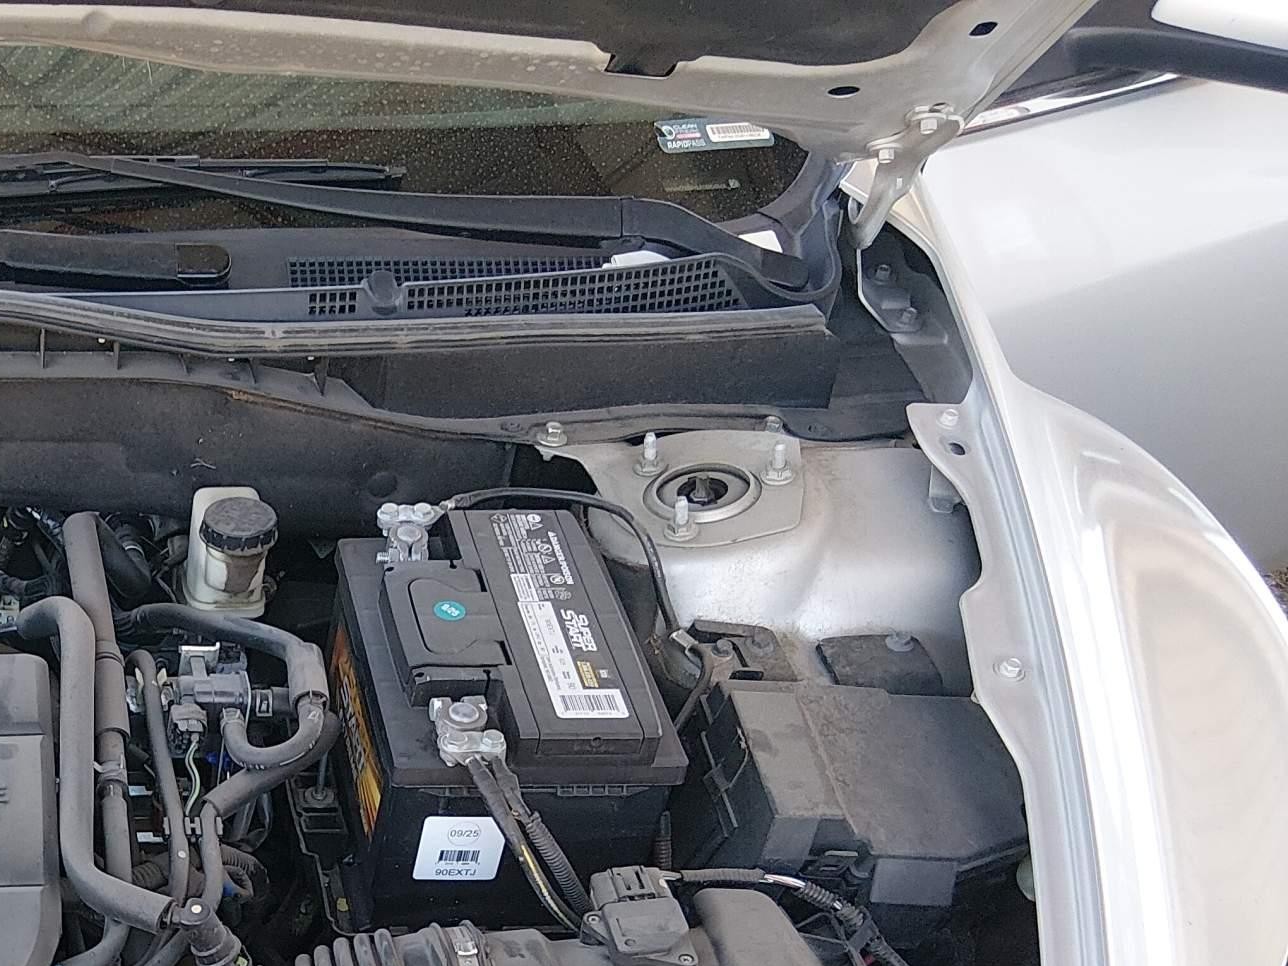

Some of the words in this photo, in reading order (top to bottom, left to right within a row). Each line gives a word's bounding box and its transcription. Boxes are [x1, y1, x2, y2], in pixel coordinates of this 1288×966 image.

[560, 609, 584, 650] START
[578, 614, 597, 652] SUPER
[449, 829, 479, 838] 09/25
[435, 868, 477, 877] 90EXTJ
